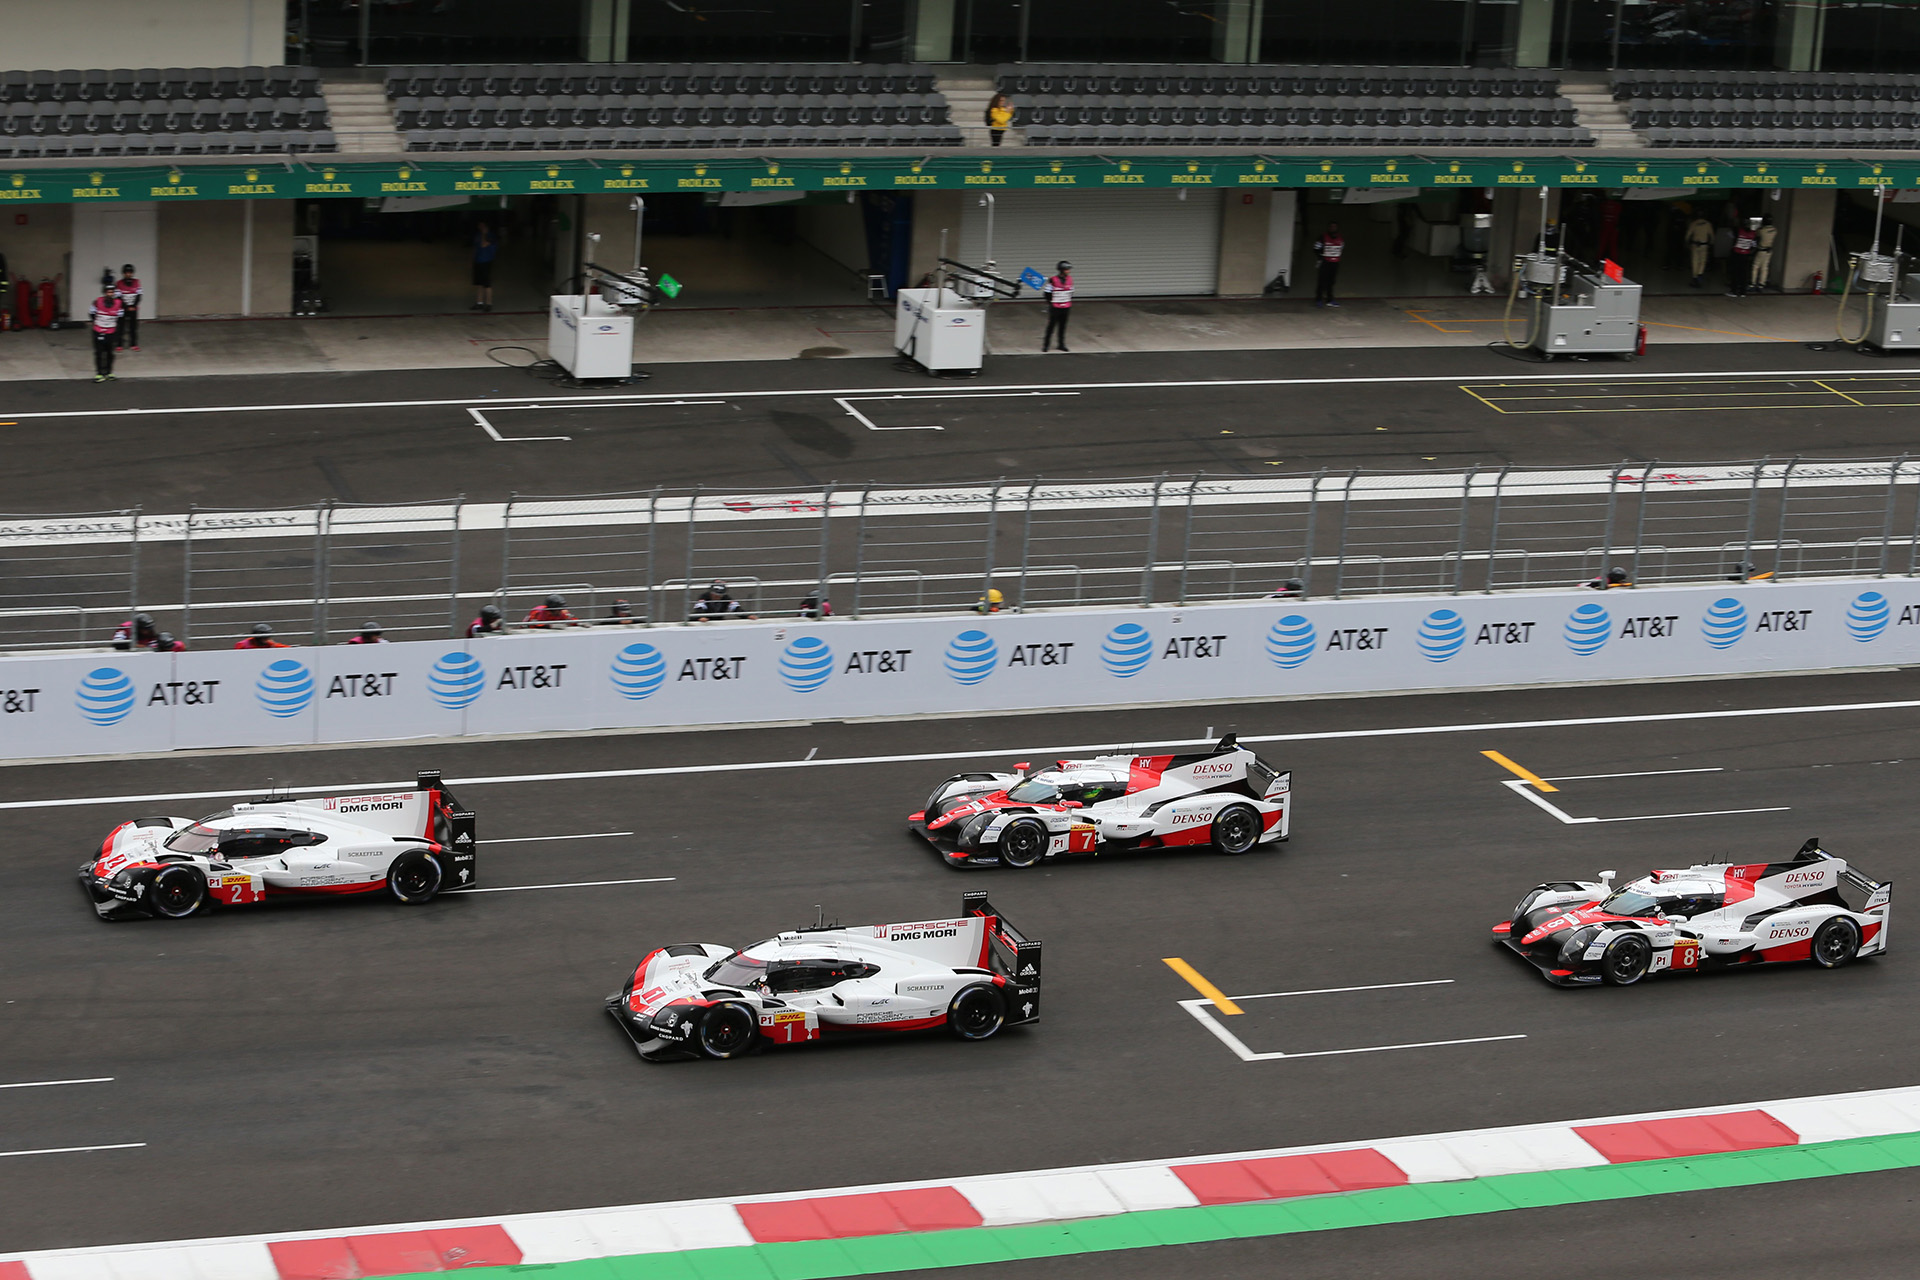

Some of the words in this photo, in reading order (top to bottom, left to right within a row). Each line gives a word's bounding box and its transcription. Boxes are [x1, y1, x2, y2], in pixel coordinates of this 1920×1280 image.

[604, 180, 649, 188] ROLEX
[678, 179, 722, 187] ROLEX
[751, 178, 795, 186] ROLEX
[823, 177, 867, 185] ROLEX
[894, 176, 937, 184] ROLEX
[964, 176, 1007, 184] ROLEX
[1034, 176, 1076, 184] ROLEX
[1103, 175, 1145, 183] ROLEX
[1171, 175, 1212, 183] ROLEX
[1239, 175, 1279, 183] ROLEX
[1497, 175, 1536, 183] ROLEX
[1683, 176, 1719, 184] ROLEX
[228, 185, 275, 194] ROLEX
[305, 184, 352, 192] ROLEX
[381, 183, 427, 191] ROLEX
[455, 182, 501, 190] ROLEX
[530, 180, 575, 189] ROLEX
[73, 188, 120, 197] ROLEX
[151, 187, 198, 195] ROLEX
[41, 522, 125, 533] STATE
[1755, 610, 1813, 632] AT&T
[1619, 616, 1679, 638] AT&T
[1474, 622, 1536, 644] AT&T
[1325, 628, 1389, 651] AT&T
[1162, 636, 1227, 659] AT&T
[1008, 643, 1074, 666] AT&T
[844, 650, 912, 674] AT&T
[677, 657, 747, 681] AT&T
[496, 665, 567, 689] AT&T
[326, 673, 398, 698] AT&T
[147, 681, 220, 706] AT&T
[1139, 759, 1151, 768] HY
[1193, 763, 1233, 774] DENSO
[323, 797, 337, 810] HY
[339, 794, 413, 804] PORSCHE
[340, 804, 369, 813] DMG
[370, 802, 403, 811] MORI
[1172, 812, 1213, 824] DENSO
[1054, 839, 1064, 848] P1
[1081, 832, 1093, 850] 7
[1733, 868, 1745, 878] HY
[1785, 871, 1824, 883] DENSO
[209, 878, 220, 887] P1
[231, 884, 242, 903] 2
[891, 920, 969, 932] PORSCHE
[874, 925, 887, 938] HY
[891, 931, 922, 942] DMG
[923, 929, 957, 939] MORI
[1769, 927, 1809, 939] DENSO
[1656, 956, 1666, 965] P1
[1683, 947, 1695, 966] 8
[907, 984, 945, 992] SCHAEFFLER
[760, 1016, 772, 1024] P1
[658, 1033, 684, 1041] CHOPARD
[784, 1023, 793, 1042] 1
